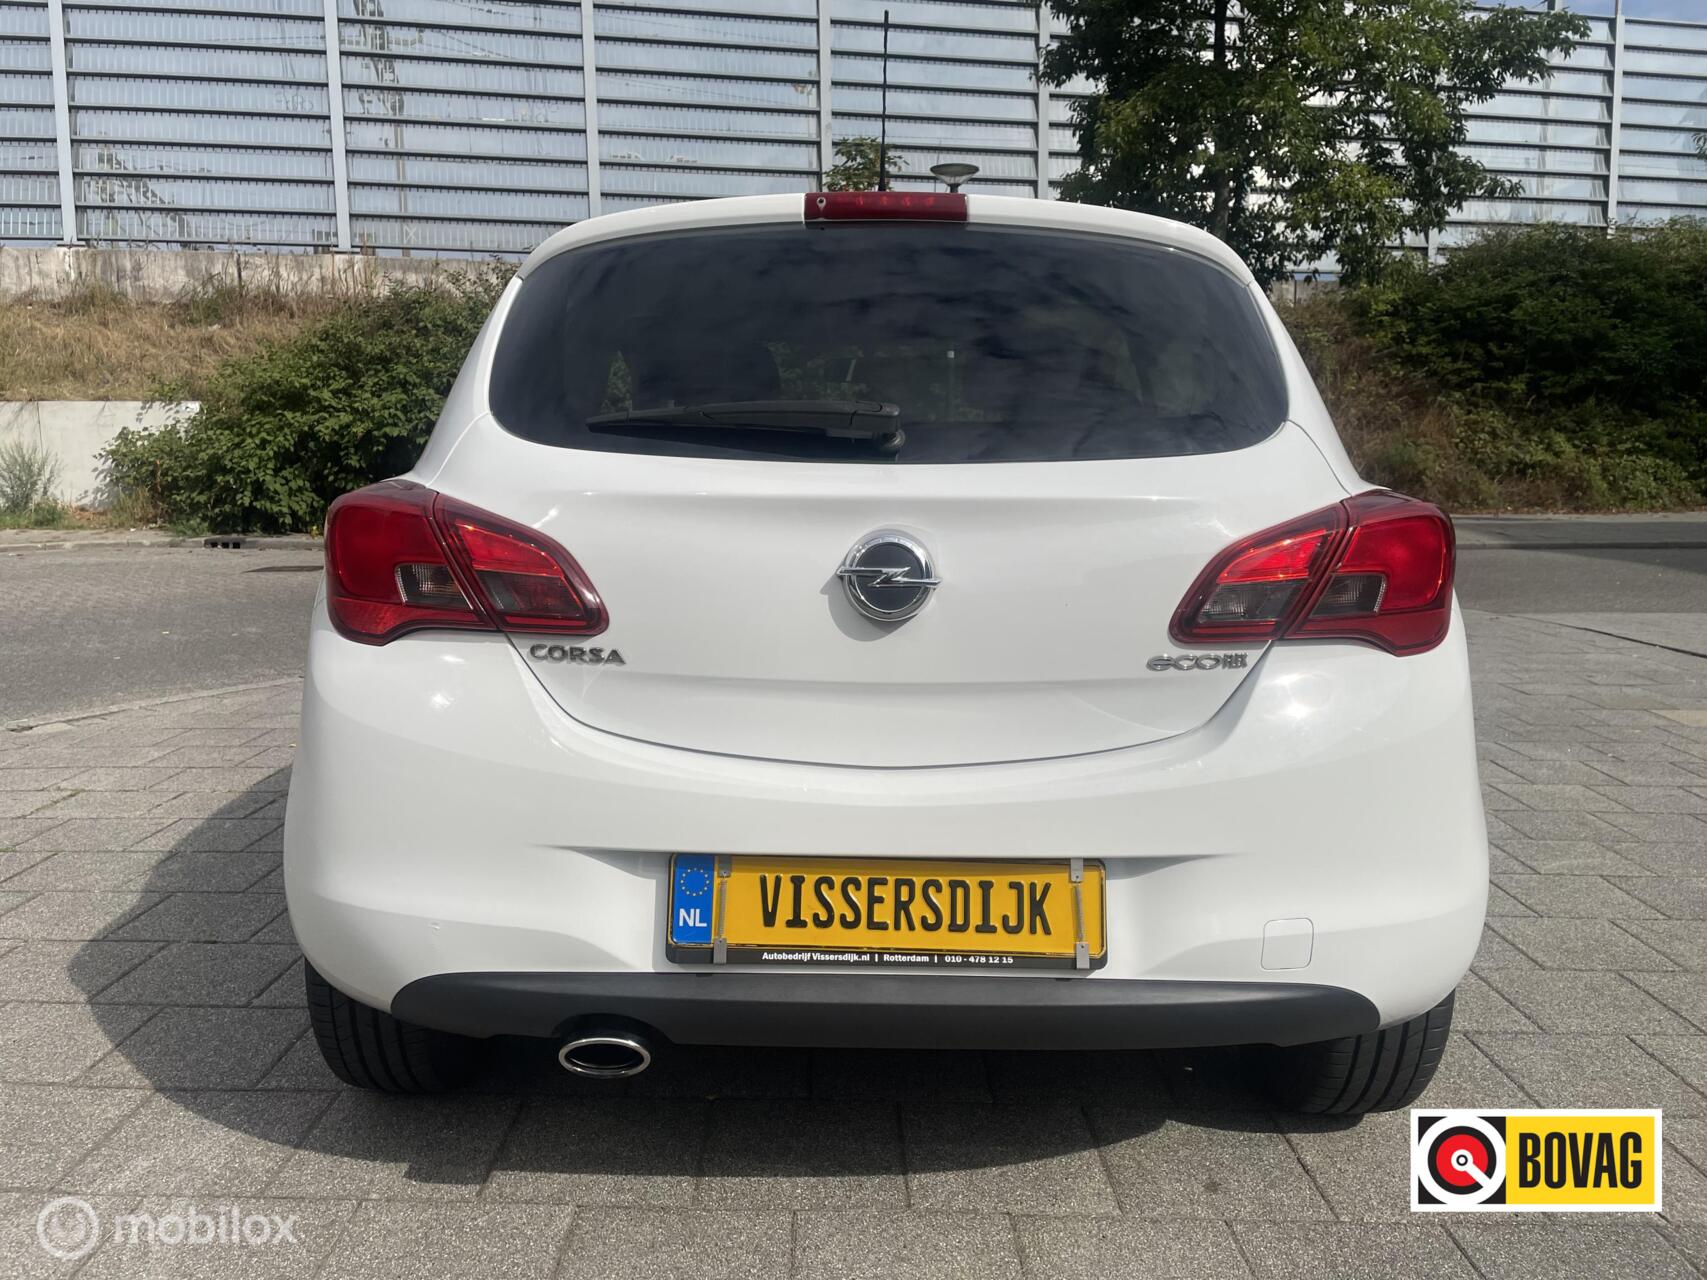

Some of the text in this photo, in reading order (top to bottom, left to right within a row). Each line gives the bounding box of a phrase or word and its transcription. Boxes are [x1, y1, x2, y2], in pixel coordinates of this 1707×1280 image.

[529, 644, 626, 665] CORSA
[758, 874, 1053, 935] VISSERSDIJK
[678, 908, 707, 928] NL
[762, 952, 811, 962] Autobedrijf
[812, 952, 870, 963] Vissersdijk.nl
[883, 954, 929, 962] Rotterdam
[945, 955, 961, 963] 010
[968, 955, 986, 964] 478
[988, 956, 1000, 964] 12
[1001, 956, 1014, 964] 15
